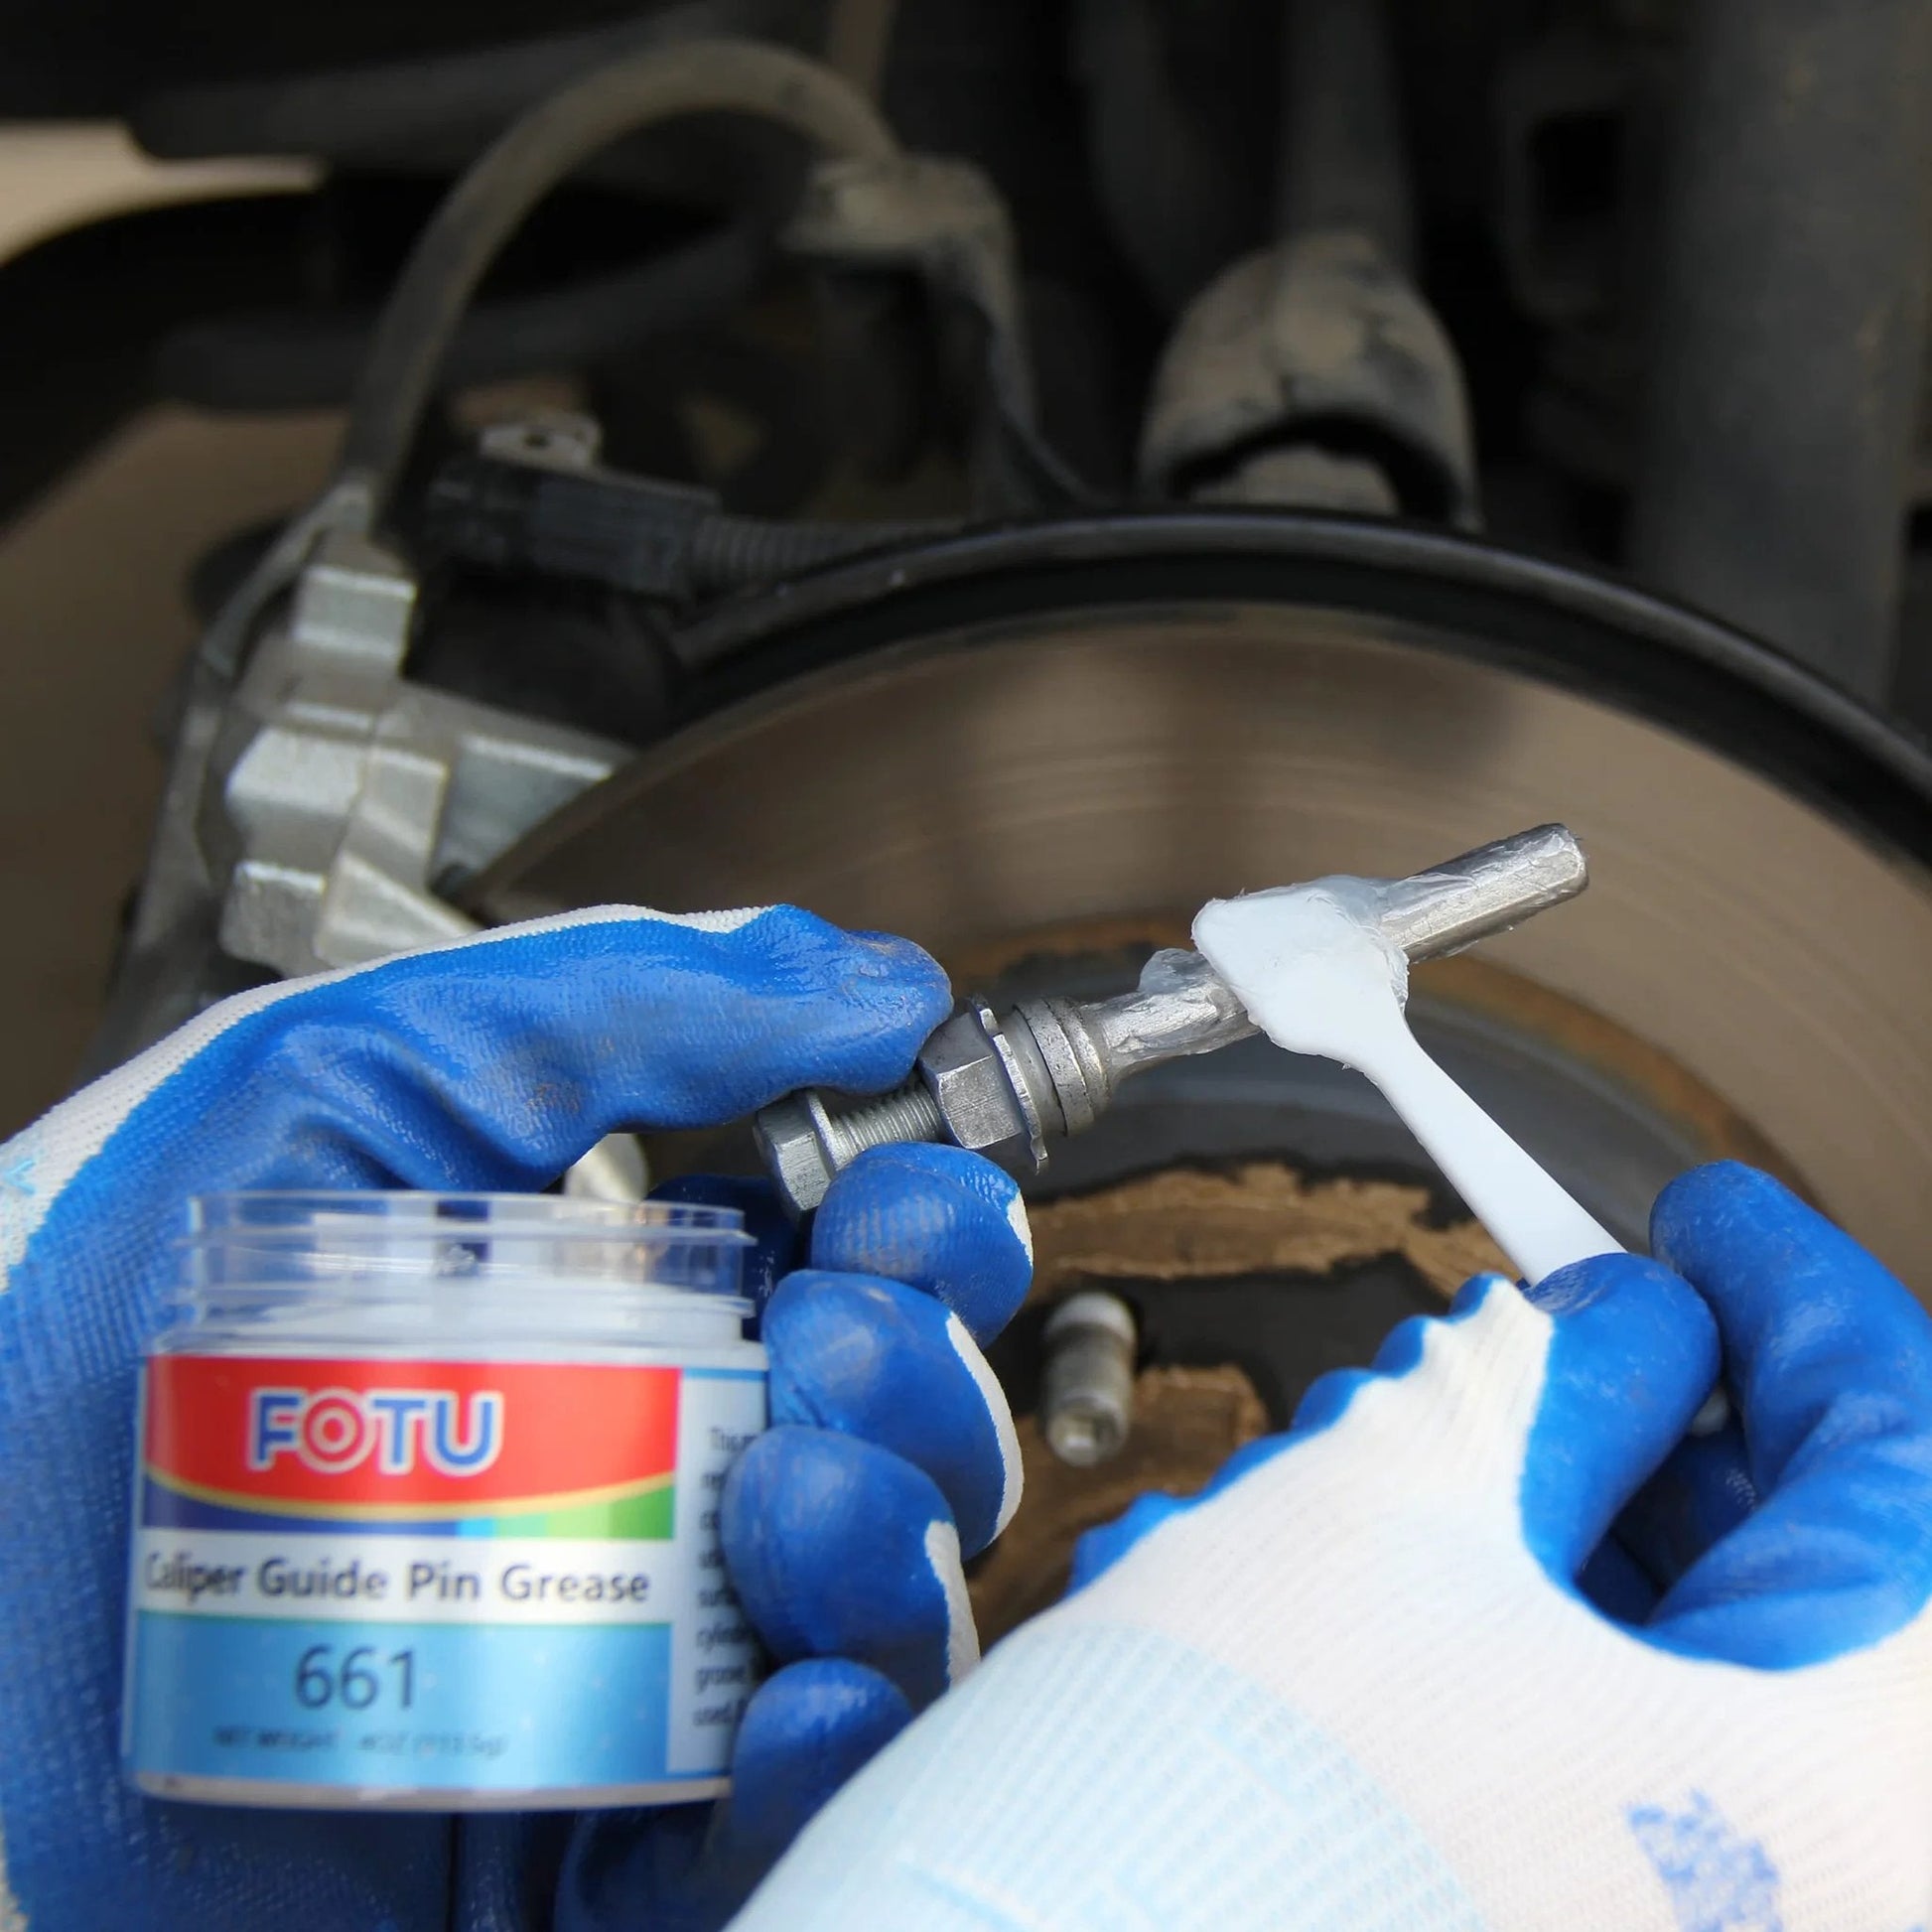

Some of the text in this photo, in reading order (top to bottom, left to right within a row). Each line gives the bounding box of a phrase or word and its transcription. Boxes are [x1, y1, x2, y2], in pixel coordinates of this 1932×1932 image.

[248, 1387, 503, 1476] FOTU
[146, 1551, 245, 1605] Caliper
[259, 1557, 389, 1597] Guide
[405, 1561, 481, 1600] Pin
[501, 1563, 651, 1601] Grease
[296, 1643, 414, 1710] 661
